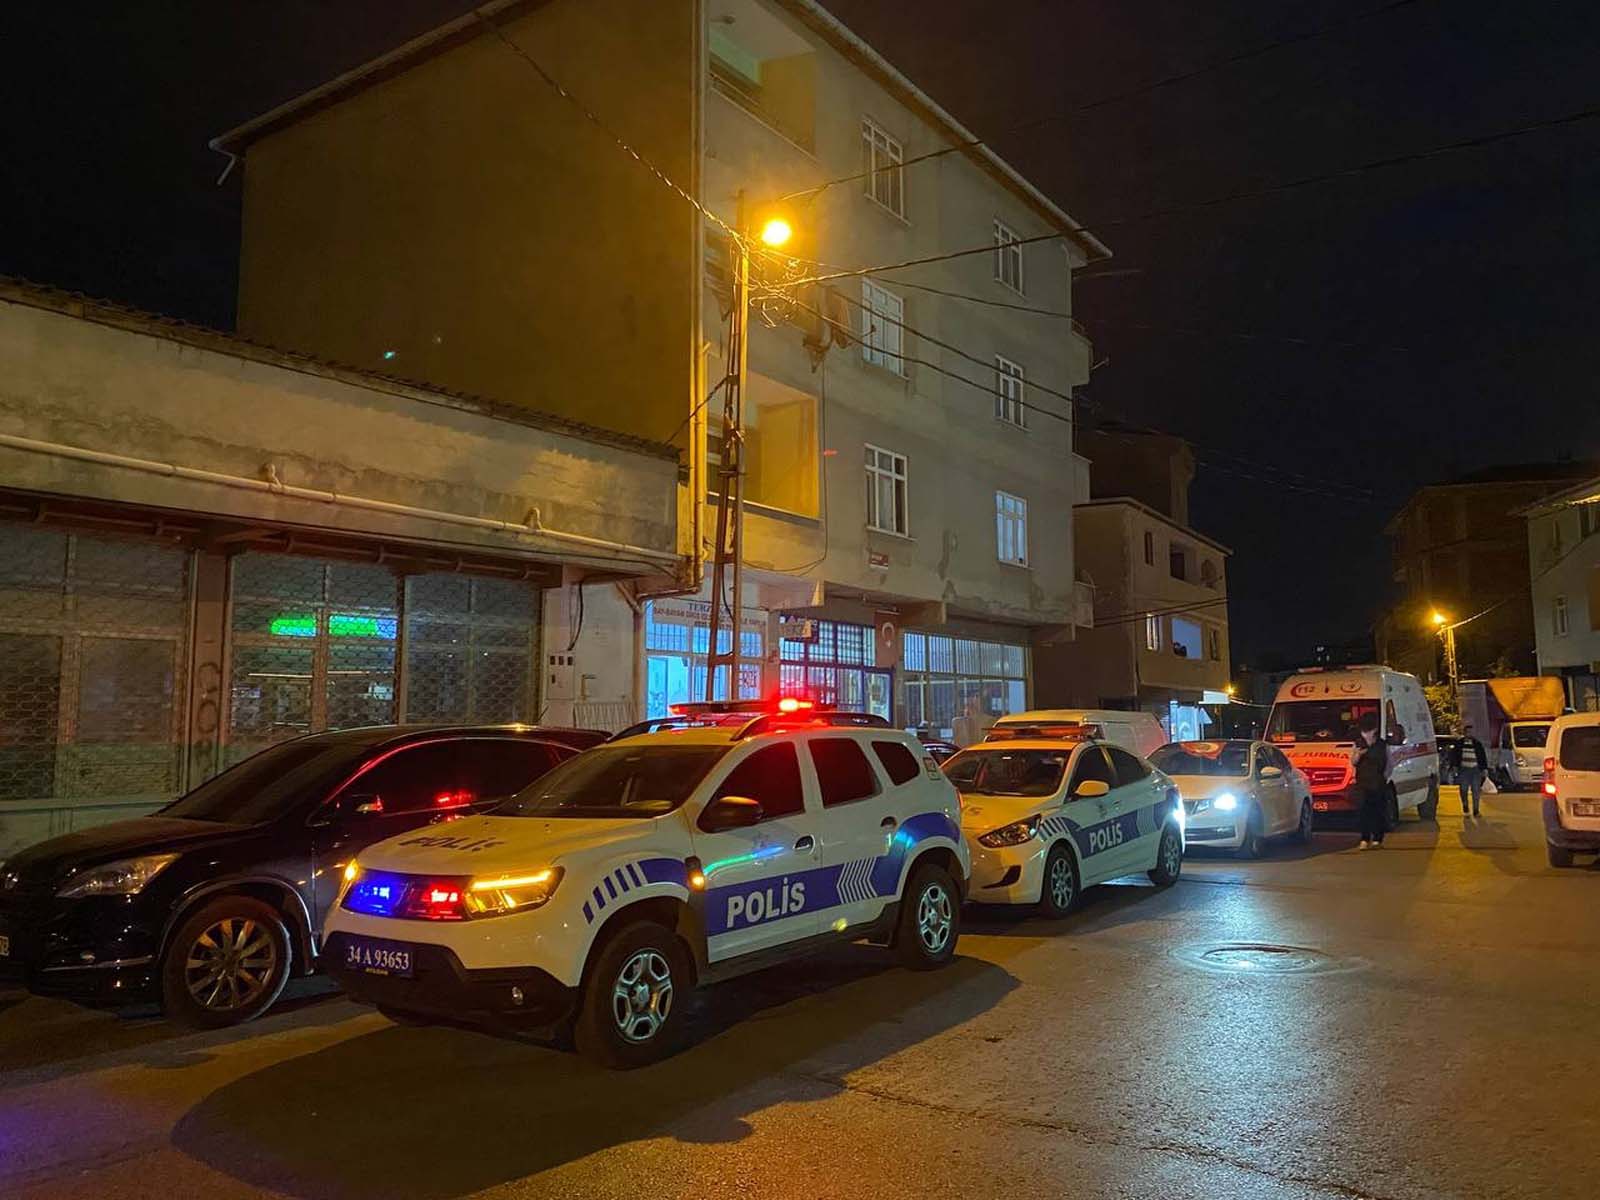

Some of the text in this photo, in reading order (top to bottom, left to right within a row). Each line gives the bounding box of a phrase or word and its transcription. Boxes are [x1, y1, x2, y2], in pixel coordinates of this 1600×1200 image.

[1088, 820, 1123, 854] POLİS
[726, 876, 806, 929] POLİS
[346, 945, 410, 971] 34 A 93653
